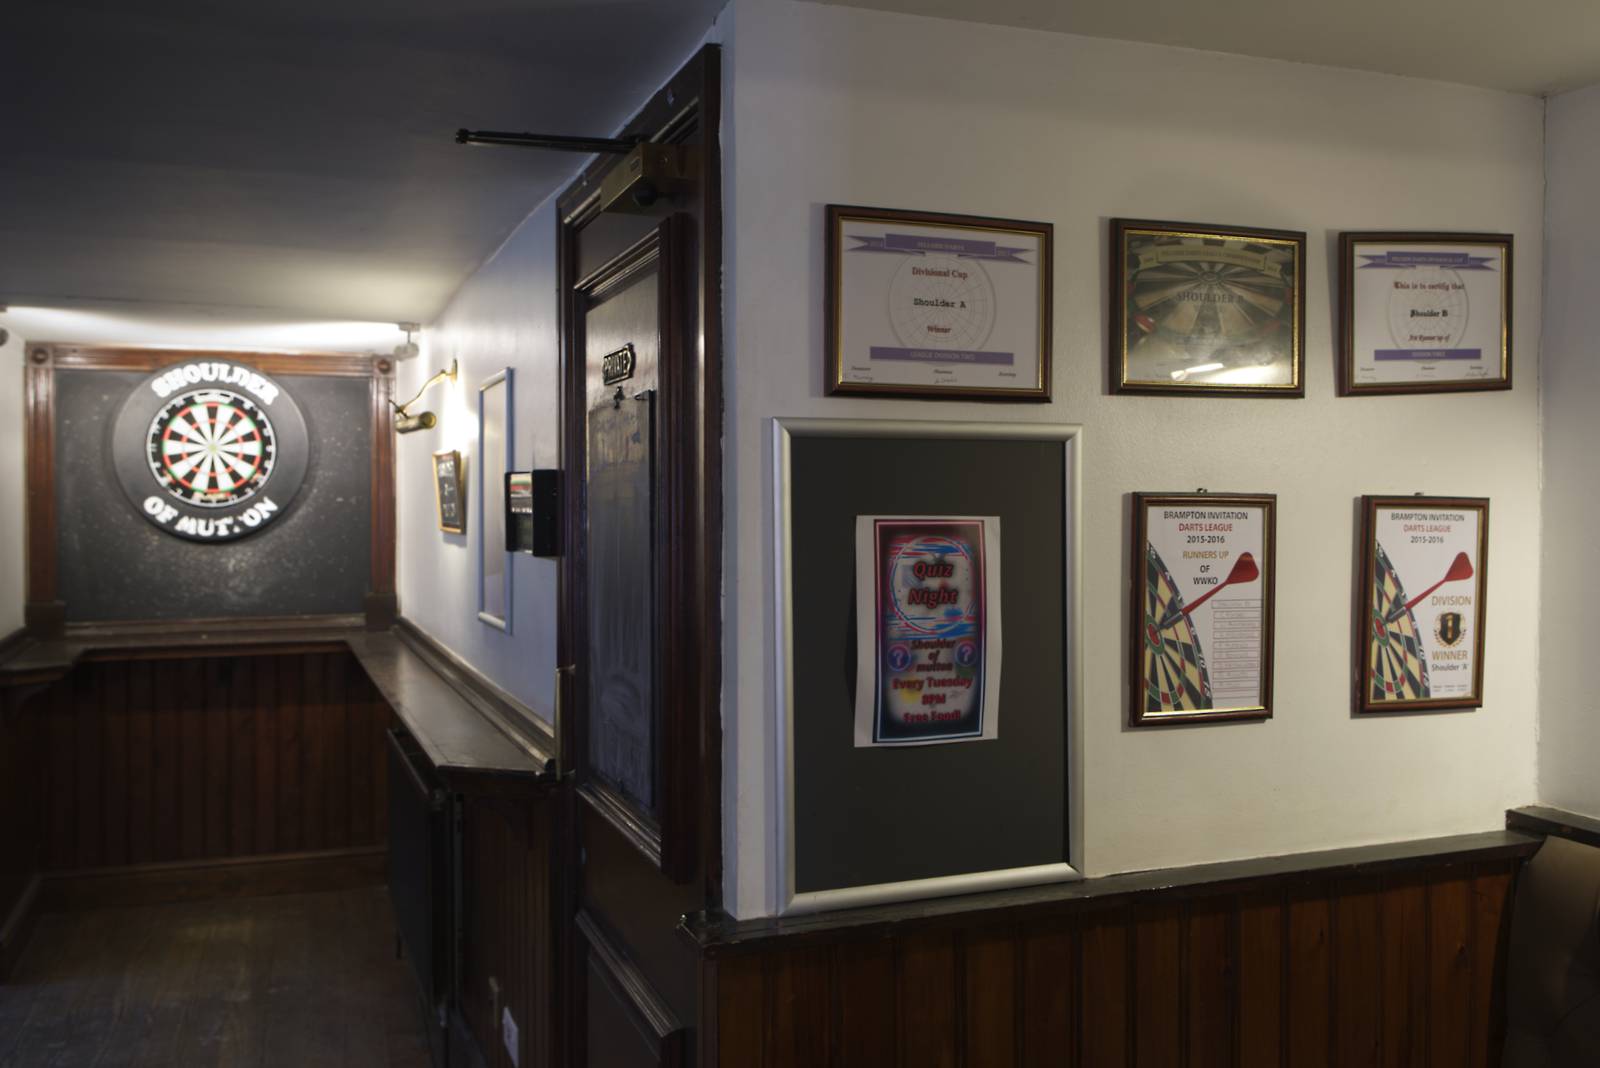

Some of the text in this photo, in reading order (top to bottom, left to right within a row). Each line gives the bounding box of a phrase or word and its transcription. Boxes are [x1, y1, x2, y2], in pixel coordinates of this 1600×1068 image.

[912, 266, 968, 280] Divisional Cup
[1176, 292, 1234, 303] SHOULDER
[913, 298, 955, 308] Shoulder
[1409, 309, 1440, 318] Shoulder
[151, 362, 279, 405] SHOULDER
[143, 496, 178, 523] OF
[1163, 511, 1248, 520] BRAMPTON INVITATION
[1391, 512, 1465, 521] BRAMPTON INVITATION
[1178, 523, 1233, 532] DARTS LEAGUE
[1403, 524, 1451, 533] DARTS LEAGUE
[1186, 535, 1226, 544] 2015-2016
[1410, 535, 1445, 544] 2015-2016
[1182, 550, 1230, 560] RUNNERS UP
[912, 560, 954, 581] Quiz
[1199, 564, 1211, 574] OF
[1192, 576, 1219, 585] WWKO
[907, 586, 959, 609] Night
[1431, 595, 1472, 606] DIVISION
[1431, 650, 1469, 660] WINNER
[1431, 663, 1460, 672] Shoulder
[892, 676, 973, 691] Every Tuesday
